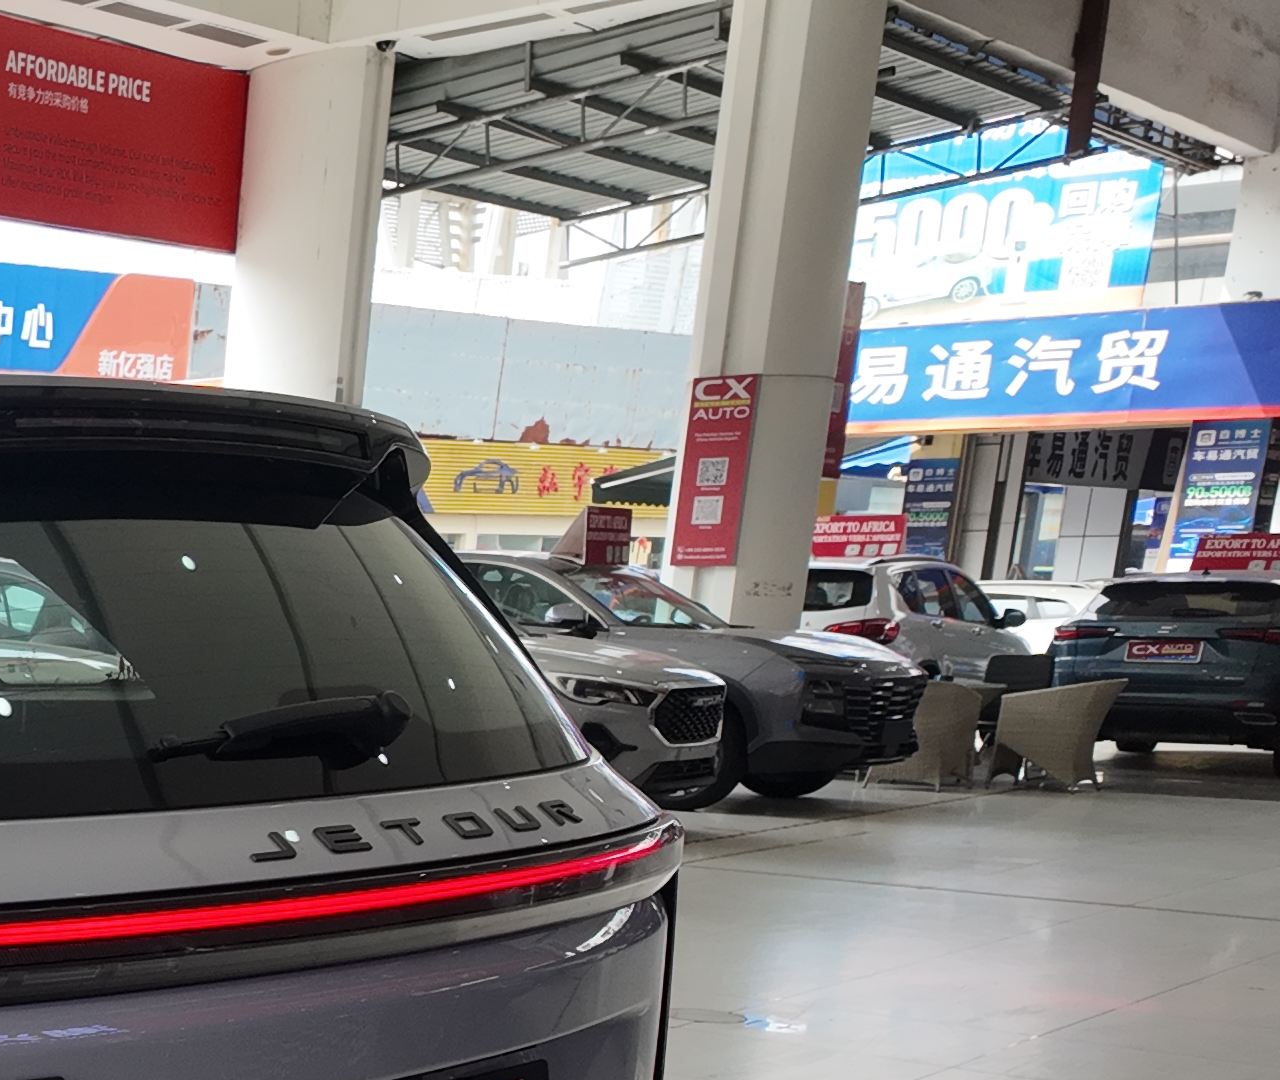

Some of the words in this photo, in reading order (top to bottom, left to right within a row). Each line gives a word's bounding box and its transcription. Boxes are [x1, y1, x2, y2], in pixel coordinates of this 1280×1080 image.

[5, 50, 106, 92] AFFORDABLE
[108, 73, 152, 102] PRICE
[7, 82, 89, 114] 有竞争力的采购价格
[97, 348, 174, 381] 新亿强店
[851, 328, 1169, 406] 易通汽贸
[694, 376, 754, 401] CX
[692, 406, 750, 421] AUTO
[814, 522, 845, 533] XPORT
[846, 522, 860, 533] TO
[860, 520, 896, 532] AFRICA
[1205, 538, 1250, 549] EXPORT
[1250, 538, 1266, 548] TO
[1132, 644, 1160, 654] CX
[250, 799, 583, 863] JETOUR
